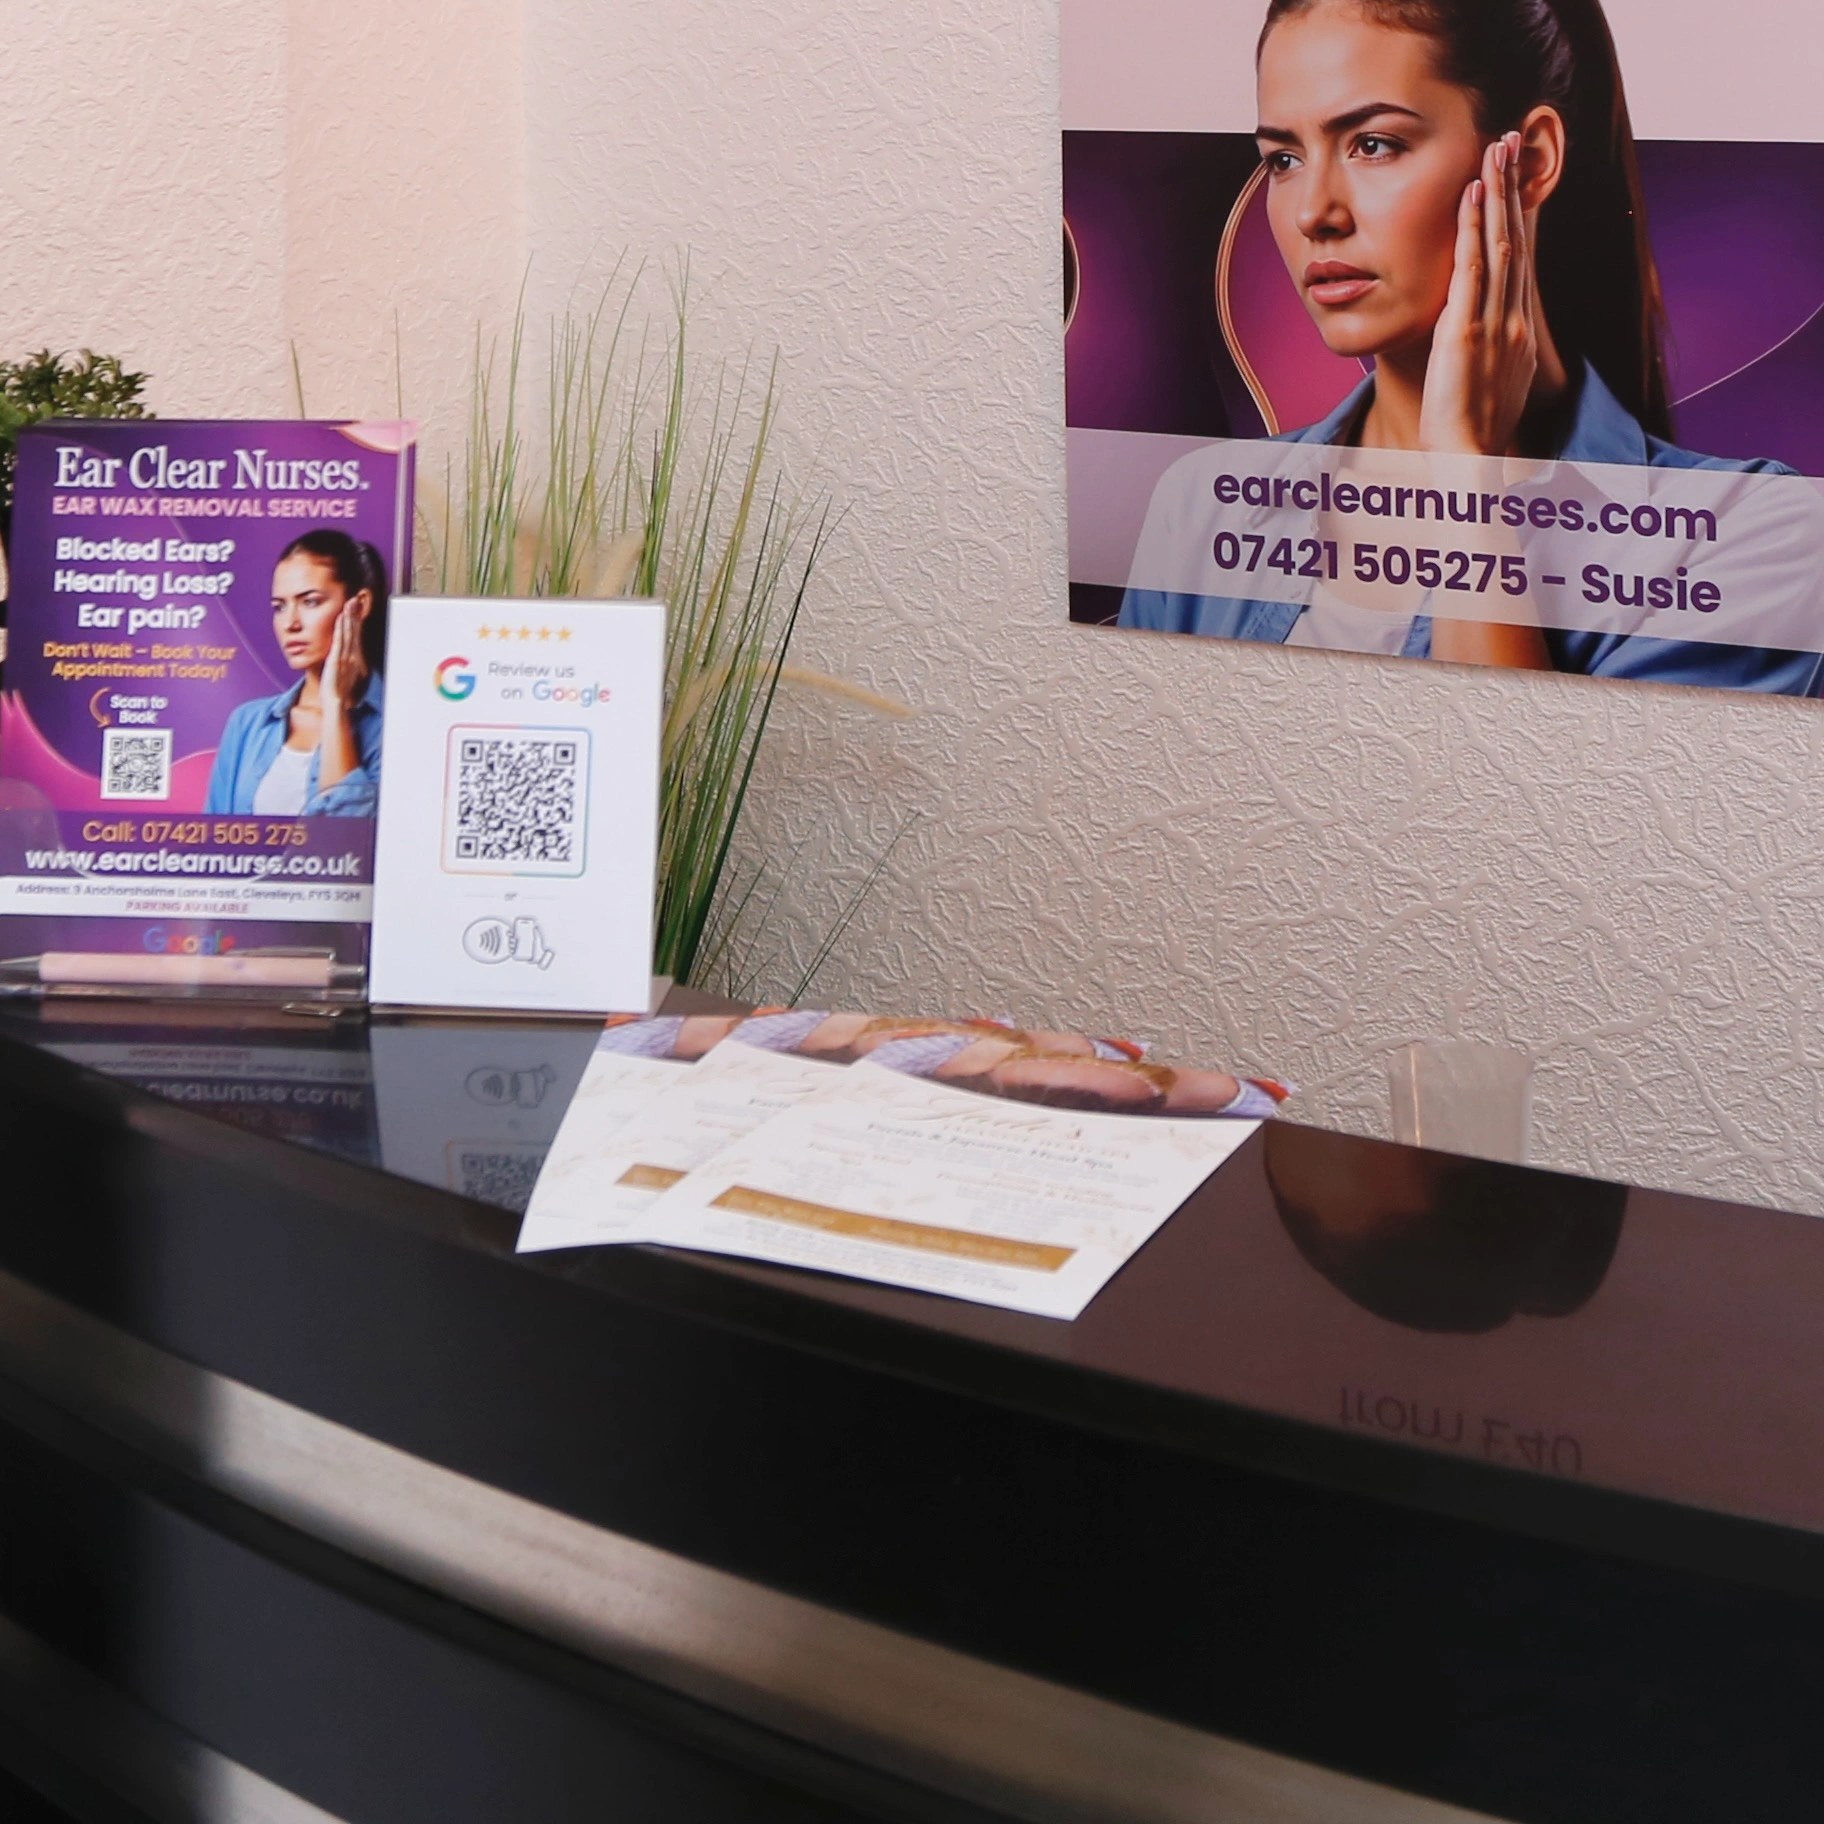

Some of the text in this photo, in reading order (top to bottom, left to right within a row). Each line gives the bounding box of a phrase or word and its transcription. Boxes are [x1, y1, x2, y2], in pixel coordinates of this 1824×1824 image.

[53, 446, 122, 488] Ear
[128, 445, 226, 489] Clear
[52, 496, 357, 518] EAR WAX REMOVAL SERVICE
[1212, 469, 1718, 542] earclearnurses.com
[55, 538, 236, 563] Blocked Ears?
[1212, 531, 1340, 580] 07421
[1352, 544, 1528, 596] 505275
[1582, 564, 1721, 613] Susie
[53, 570, 235, 600] Hearing Loss?
[78, 603, 207, 635] Ear pain?
[92, 643, 133, 658] Wait
[151, 643, 193, 660] Book
[196, 645, 238, 660] Your
[51, 661, 228, 683] Appointment Today!
[488, 661, 575, 678] Review us
[110, 694, 169, 710] Scan to
[501, 679, 610, 708] on Google
[119, 710, 158, 725] Book
[82, 820, 308, 846] Call: 07421 505 275
[25, 848, 361, 877] www.earclearnurse.co.uk
[126, 901, 248, 914] PARKING AVAILABLE
